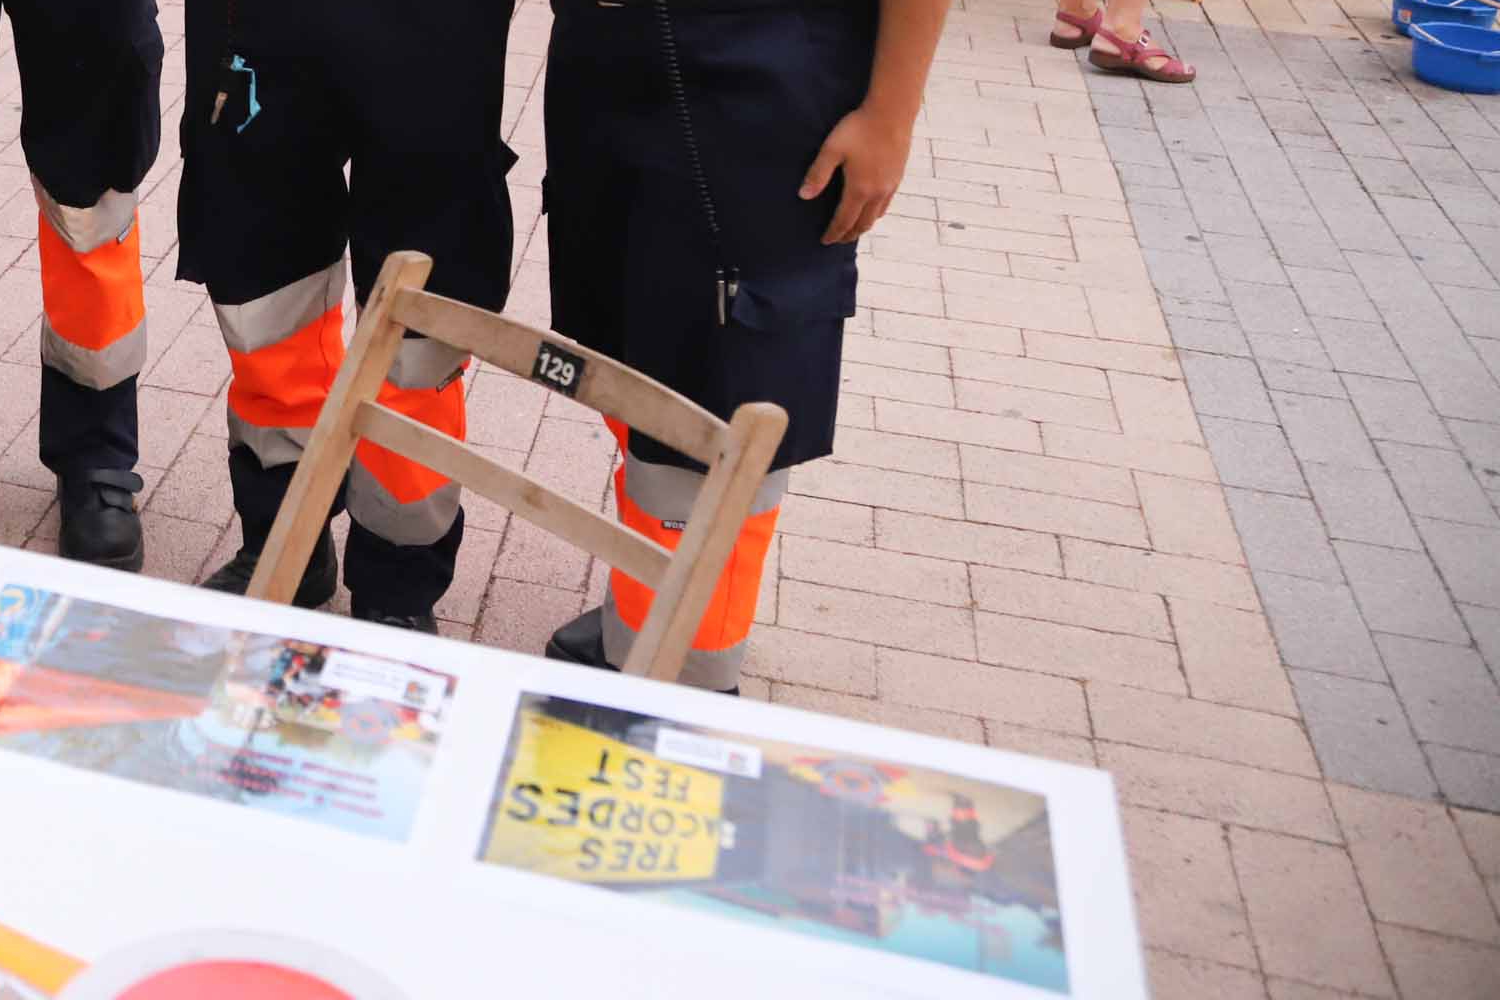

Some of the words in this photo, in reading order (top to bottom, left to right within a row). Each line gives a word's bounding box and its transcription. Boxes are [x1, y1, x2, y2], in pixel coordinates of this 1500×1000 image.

[539, 352, 575, 386] 129
[589, 748, 692, 803] FEST
[577, 838, 680, 872] TRES
